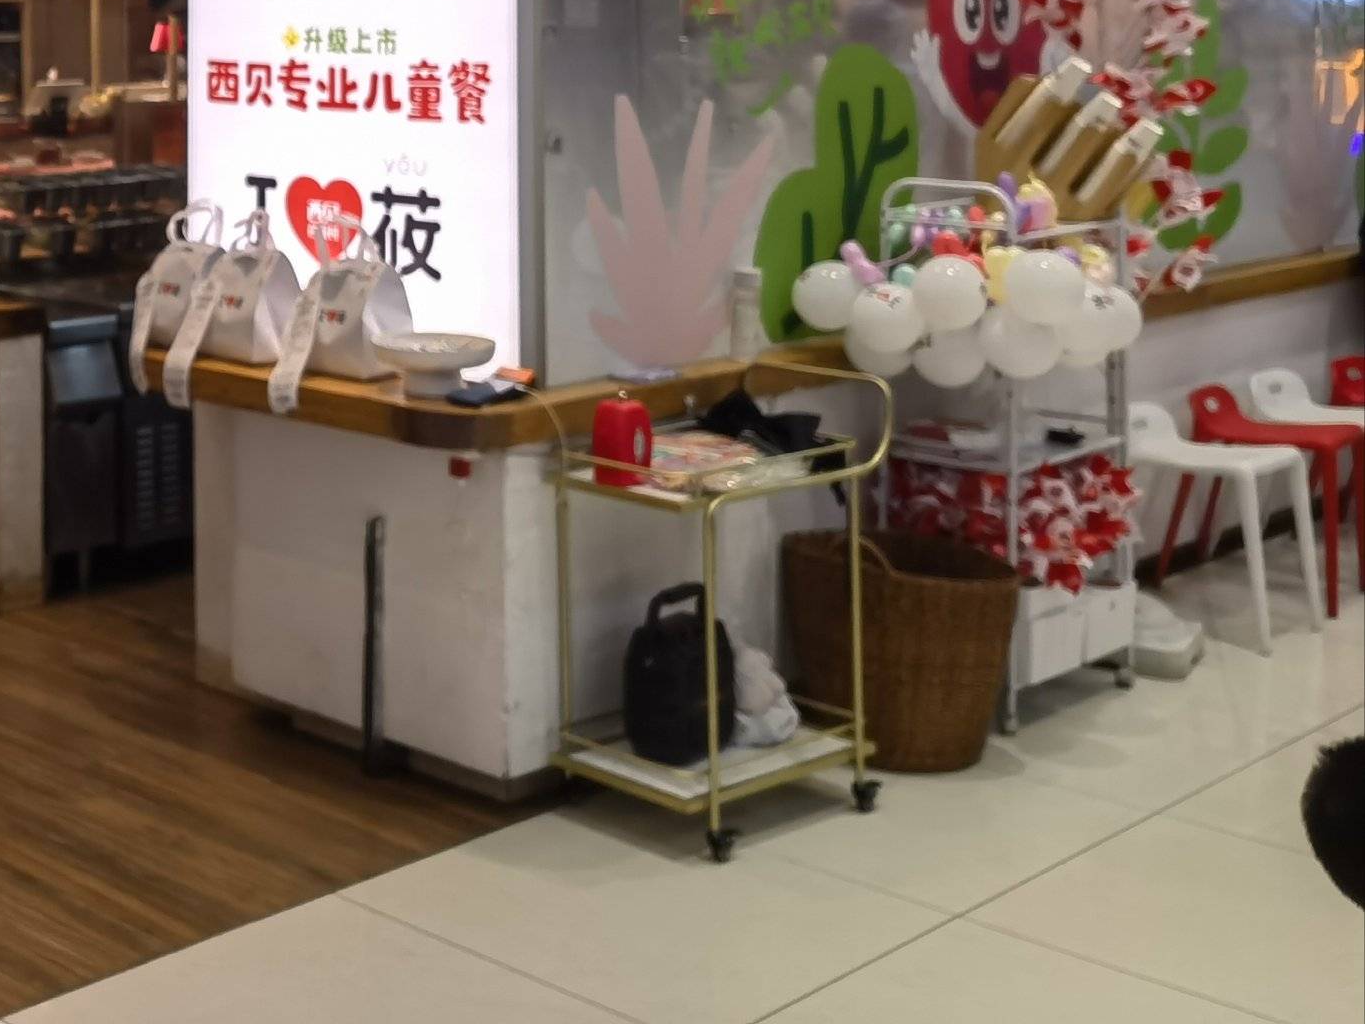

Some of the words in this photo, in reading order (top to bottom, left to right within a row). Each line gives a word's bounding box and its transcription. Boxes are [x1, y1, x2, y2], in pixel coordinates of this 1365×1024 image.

[303, 26, 398, 55] 升级上市
[206, 58, 492, 125] 西贝专业儿童餐
